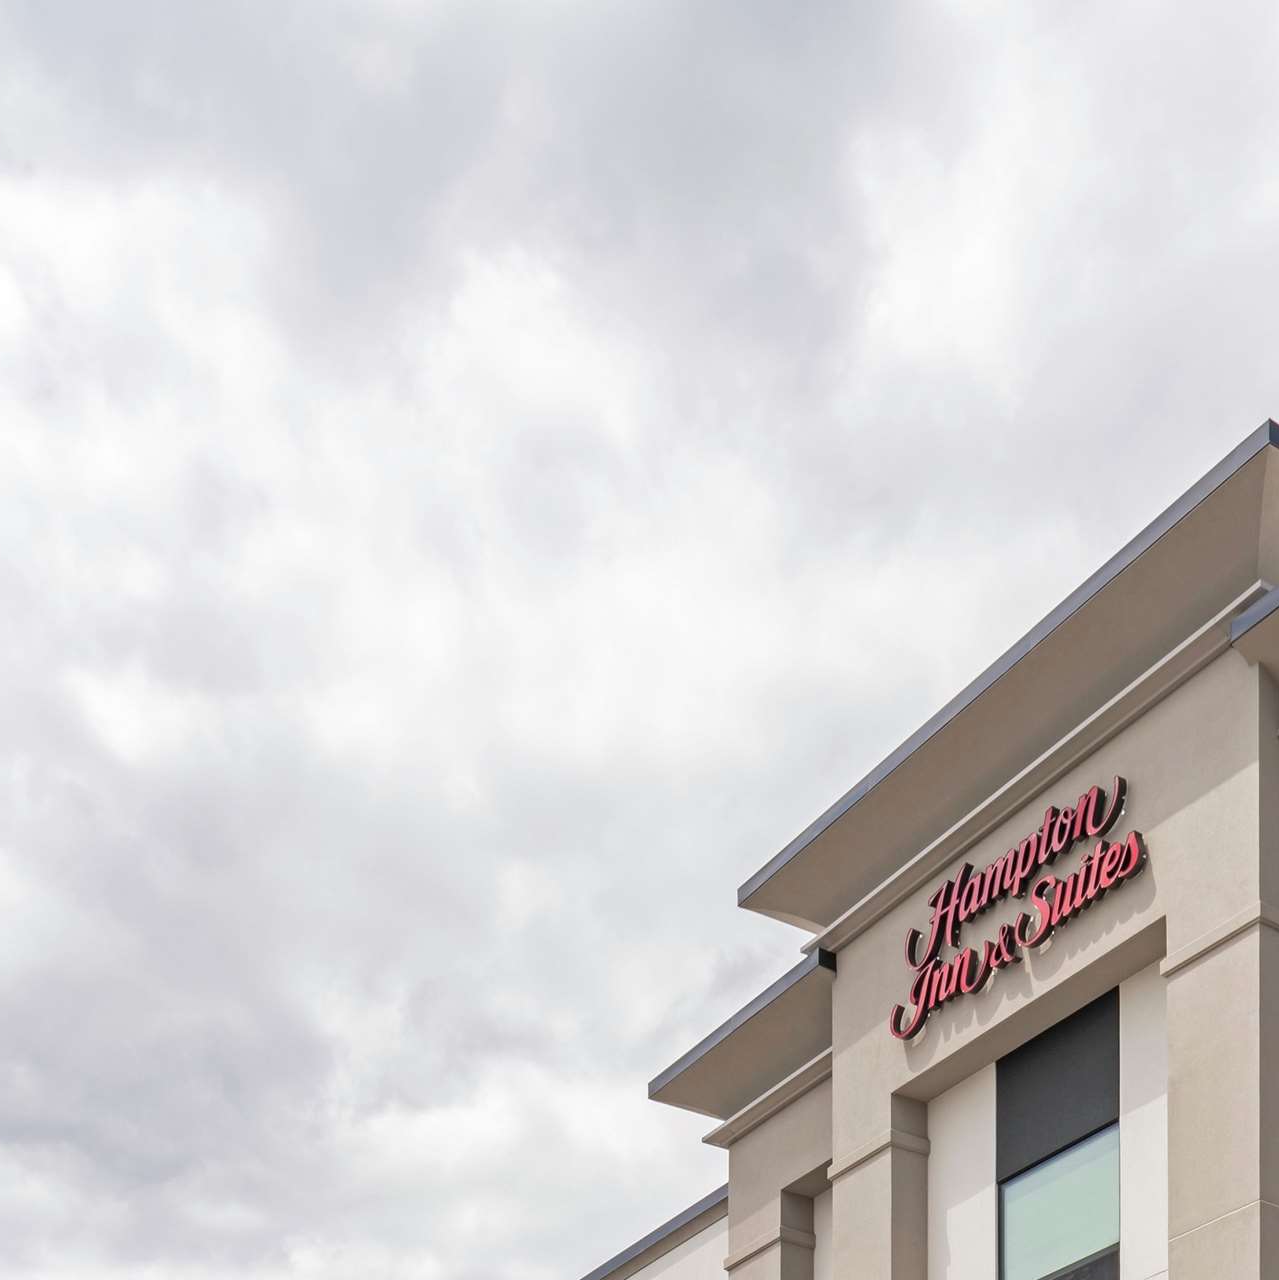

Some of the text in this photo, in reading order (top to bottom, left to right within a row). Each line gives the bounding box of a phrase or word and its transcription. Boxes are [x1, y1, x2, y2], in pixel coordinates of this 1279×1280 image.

[890, 831, 1146, 1040] Inn & Suites
[905, 776, 1127, 972] Hampton
